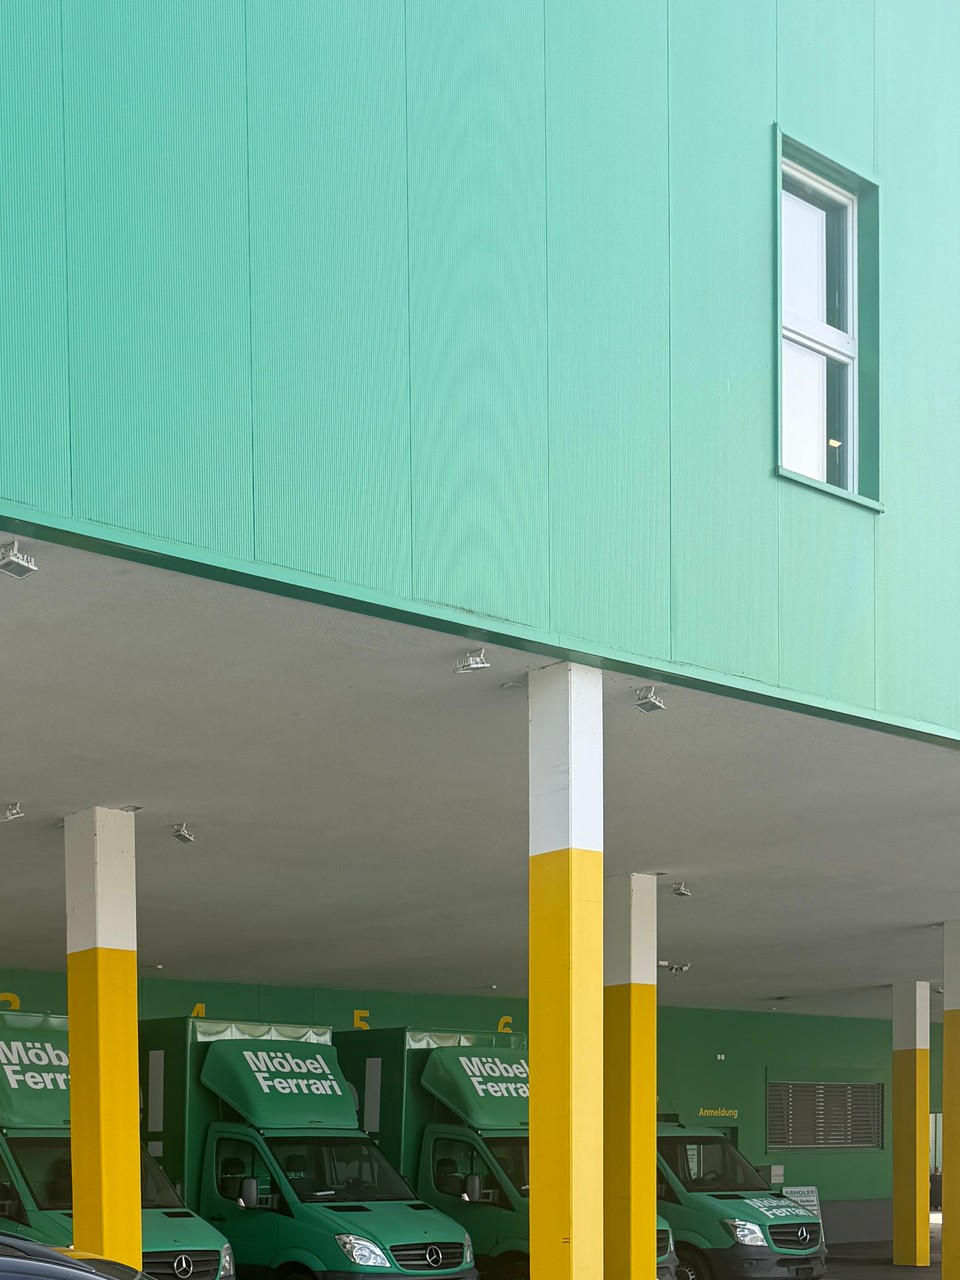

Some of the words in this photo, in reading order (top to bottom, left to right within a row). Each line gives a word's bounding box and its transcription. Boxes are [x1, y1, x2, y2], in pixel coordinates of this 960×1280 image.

[354, 1010, 370, 1031] 5
[243, 1051, 331, 1074] Möbel
[3, 1065, 71, 1090] Ferr
[255, 1072, 342, 1096] Ferrari
[470, 1077, 530, 1098] Ferra
[698, 1107, 738, 1119] Anmeldung
